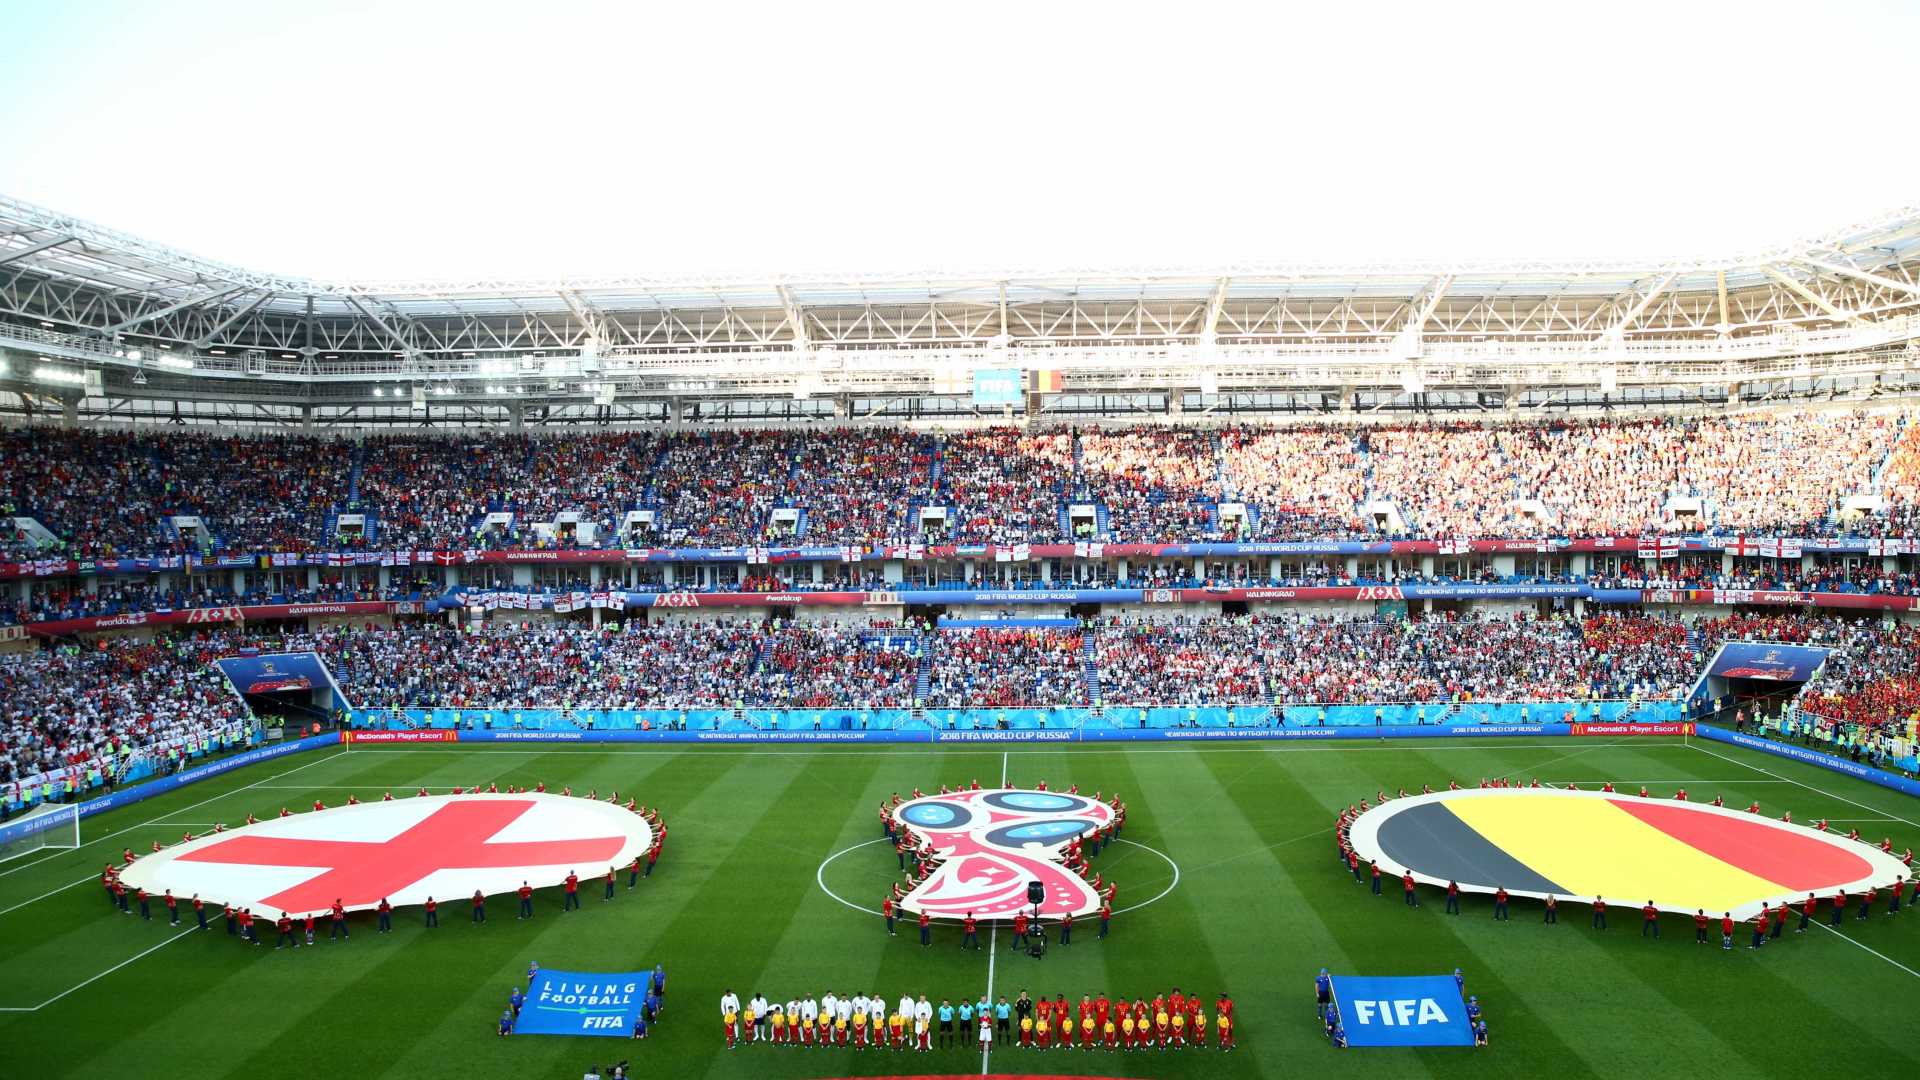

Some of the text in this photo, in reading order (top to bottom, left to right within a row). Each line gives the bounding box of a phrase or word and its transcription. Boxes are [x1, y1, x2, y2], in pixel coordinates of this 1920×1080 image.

[979, 380, 1015, 393] FIFA
[766, 594, 802, 602] #worldcup
[289, 605, 346, 614] КАЛИНИНГРАД
[1629, 726, 1651, 734] Player
[397, 733, 418, 741] Player
[940, 732, 1071, 740] 2018 FIFA WORLD CUP RUSSIA
[543, 980, 636, 994] LIVING
[539, 992, 632, 1005] FOOTBALL
[1354, 998, 1449, 1026] FIFA
[582, 1016, 624, 1029] FIFA
